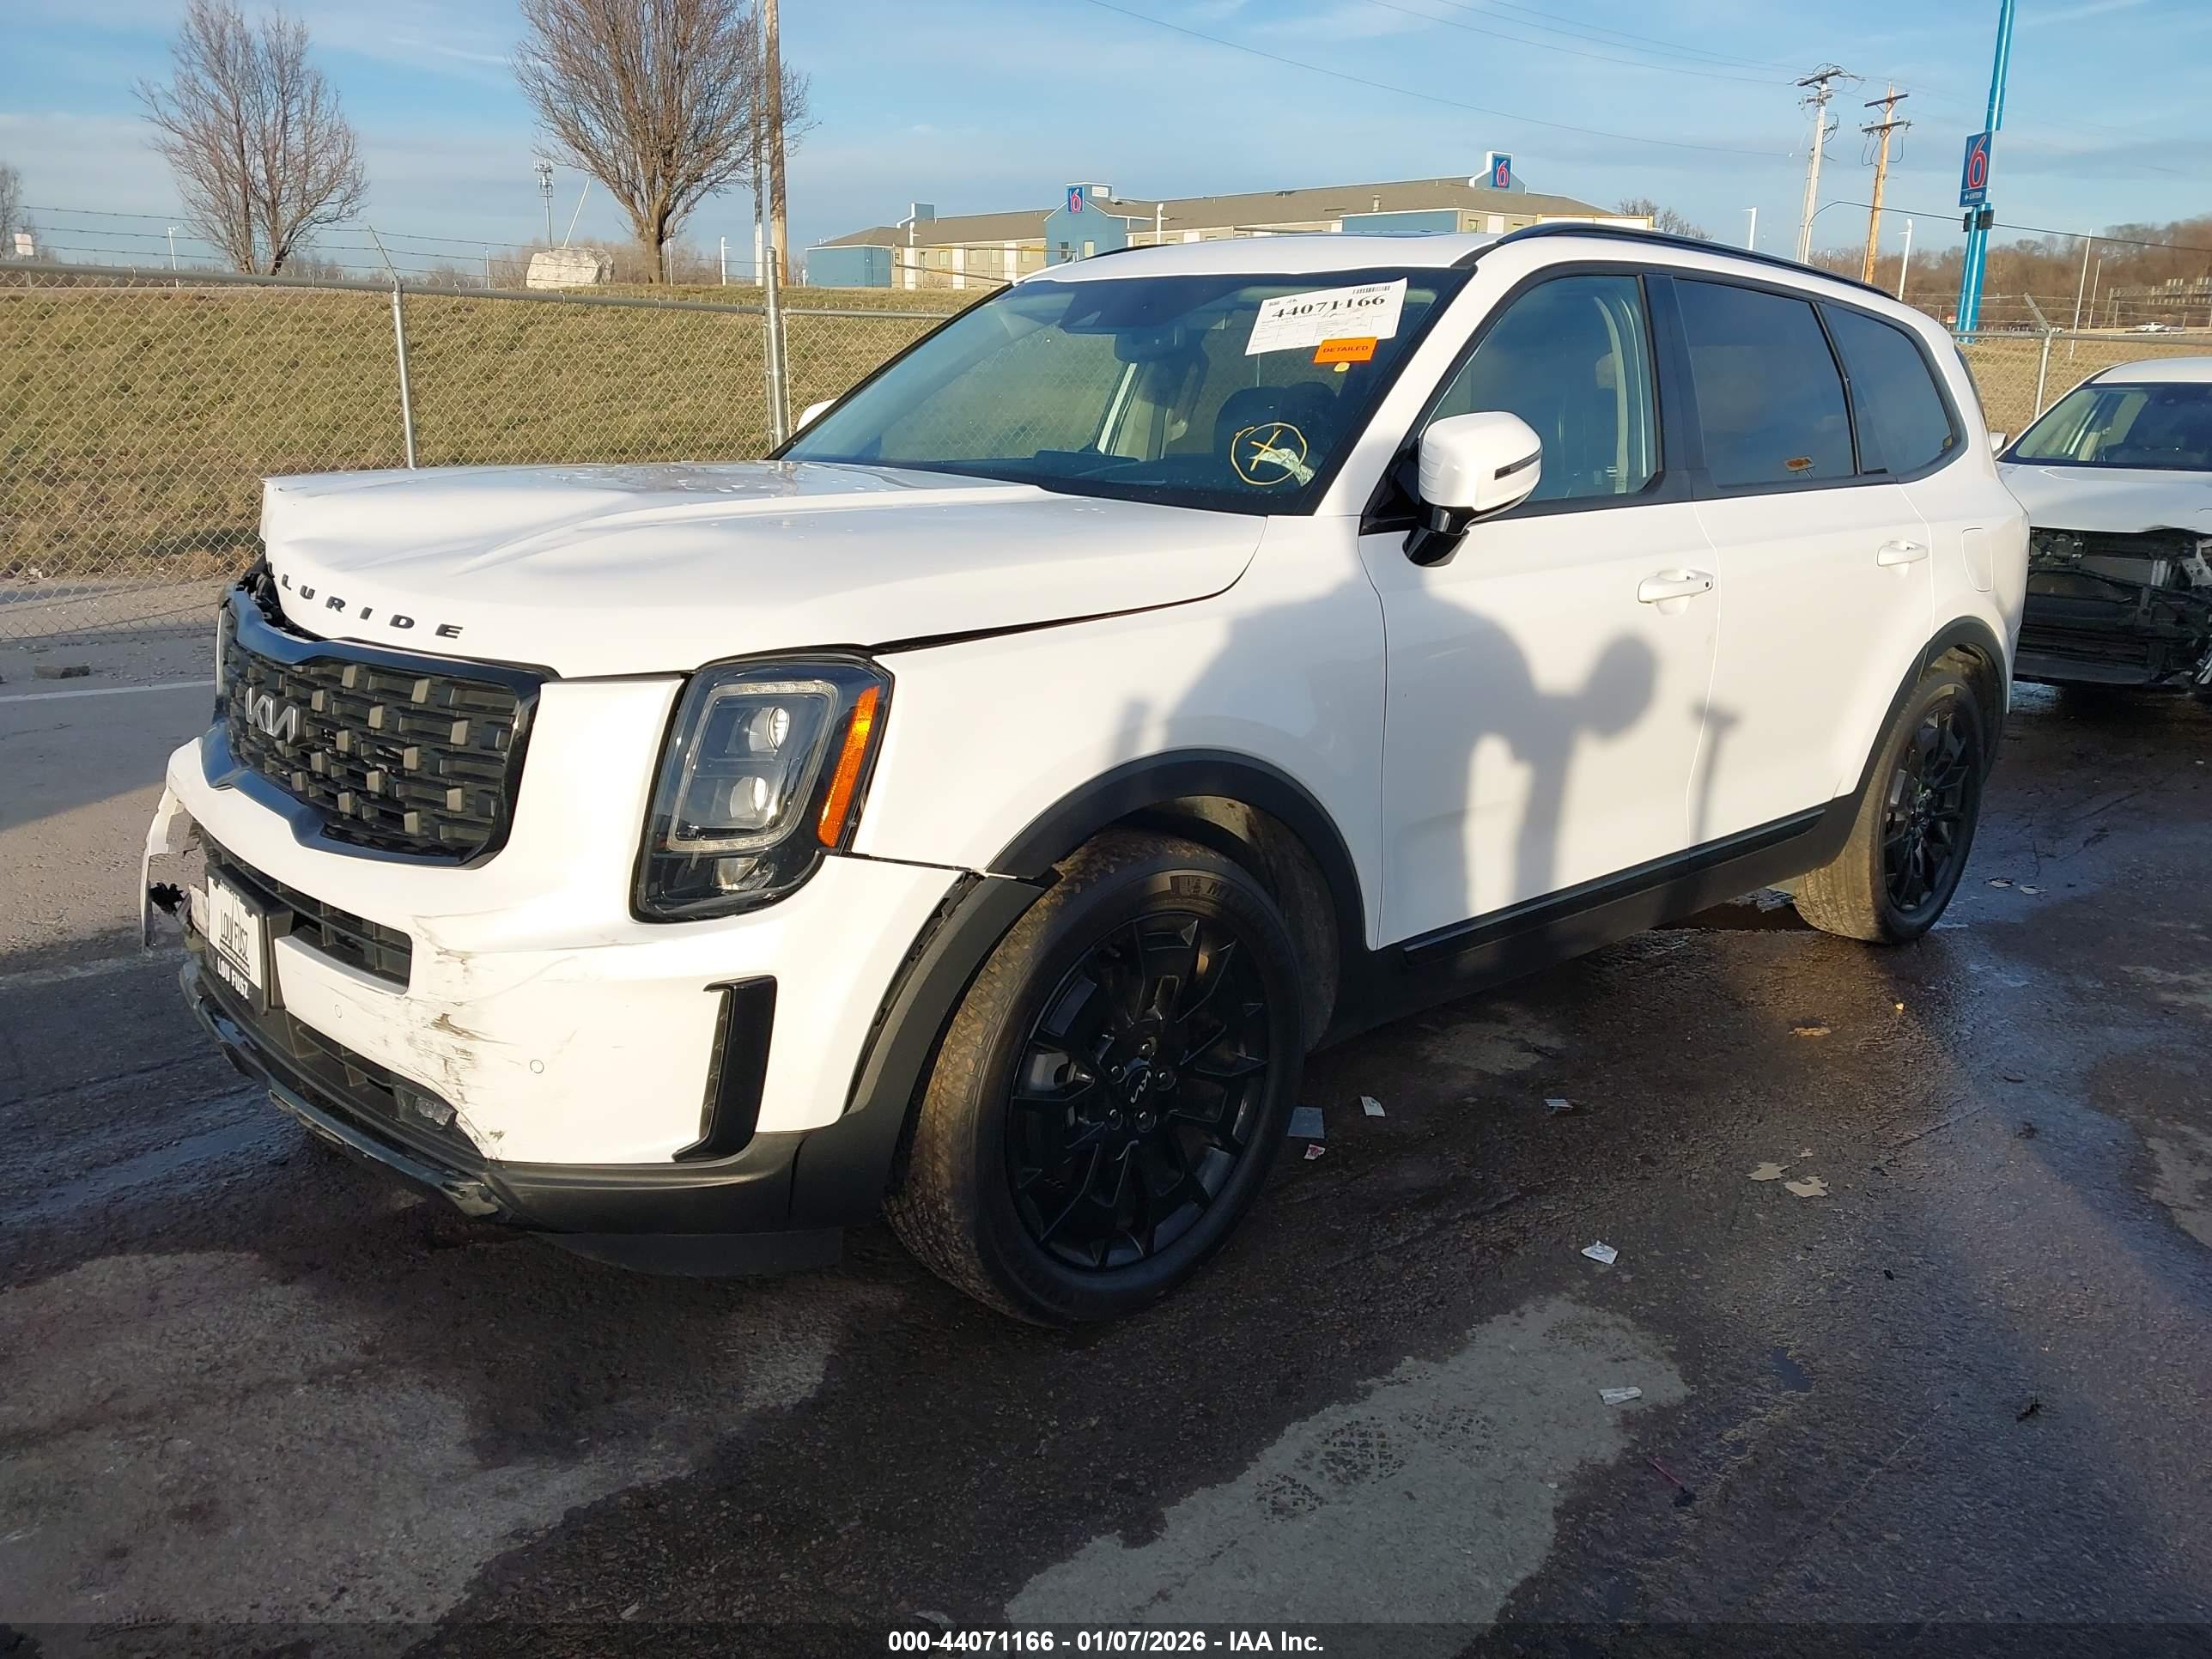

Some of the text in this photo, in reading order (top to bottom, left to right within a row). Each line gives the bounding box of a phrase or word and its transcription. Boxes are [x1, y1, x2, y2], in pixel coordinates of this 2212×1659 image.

[1497, 160, 1509, 187] 6
[1967, 135, 1987, 189] 6
[1071, 188, 1081, 213] 6
[1272, 295, 1385, 318] 44071166
[1323, 345, 1369, 354] DETAILED
[217, 956, 230, 983] LOU
[231, 969, 249, 1000] FUSZ
